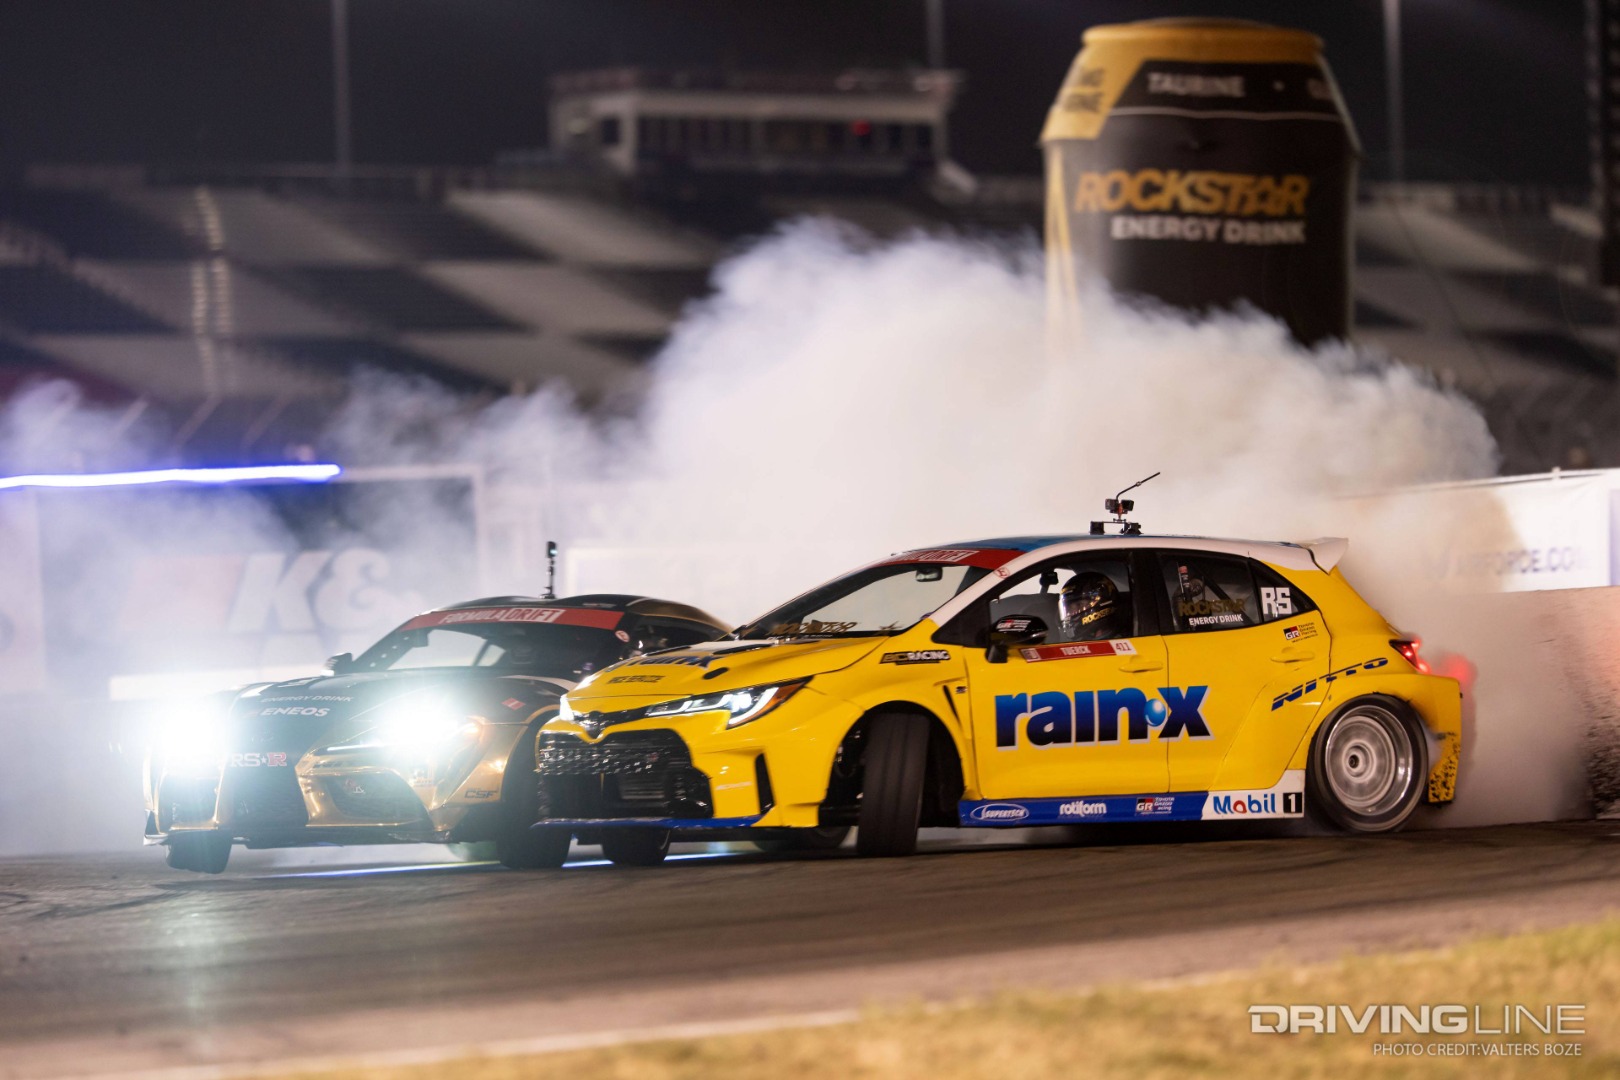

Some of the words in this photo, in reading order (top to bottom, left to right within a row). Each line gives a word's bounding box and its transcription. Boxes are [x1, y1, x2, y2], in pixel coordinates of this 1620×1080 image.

[1148, 72, 1245, 97] TAURINE
[1075, 168, 1309, 215] ROCKSTAR
[1111, 216, 1221, 241] ENERGY
[1223, 221, 1306, 244] DRINK
[1178, 599, 1246, 616] ROCKSTAR
[1260, 587, 1292, 615] RS
[439, 609, 502, 624] FORMULA
[502, 607, 565, 623] DRIFT
[1189, 616, 1219, 626] ENERGY
[1219, 614, 1244, 624] DRINK
[907, 650, 951, 661] RACING
[1115, 642, 1132, 652] 411
[1271, 657, 1389, 711] NITTO
[260, 706, 331, 717] ENEOS
[464, 789, 498, 799] CSF
[1060, 800, 1107, 817] rotiform
[1136, 802, 1153, 811] GR
[1213, 791, 1277, 816] Mobil
